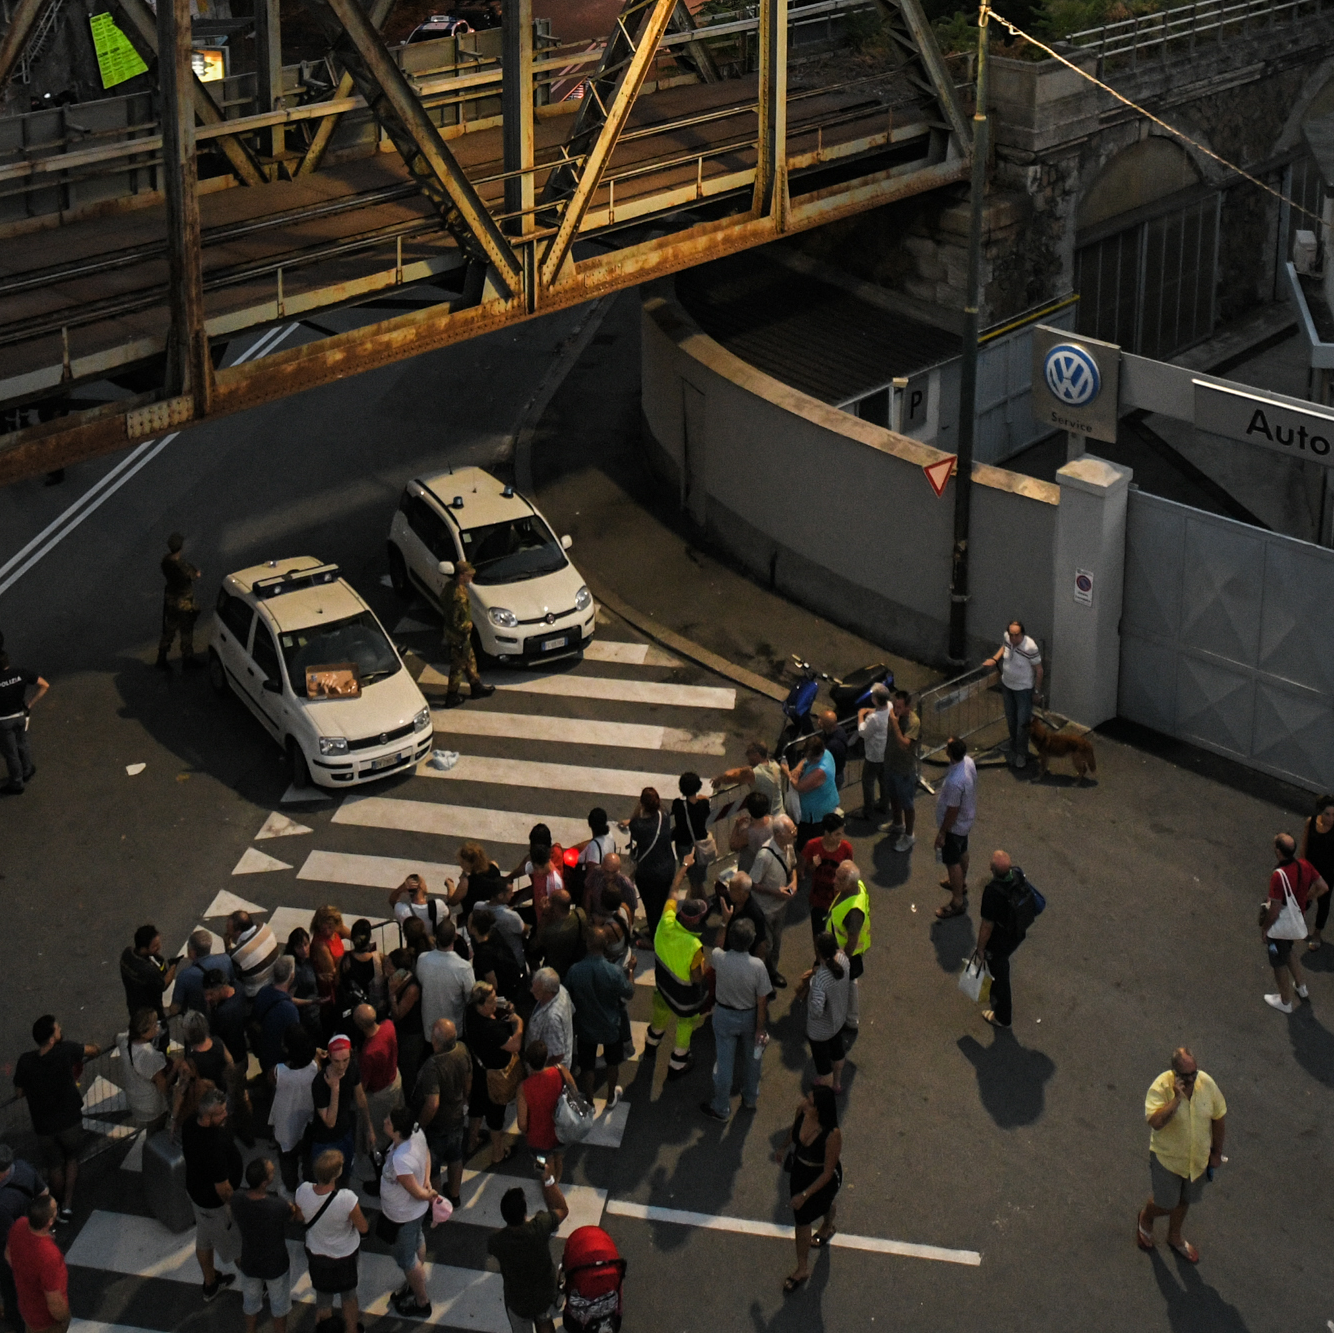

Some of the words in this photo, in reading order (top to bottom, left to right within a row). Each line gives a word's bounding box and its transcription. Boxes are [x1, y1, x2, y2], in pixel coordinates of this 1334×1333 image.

[910, 390, 922, 419] P
[1051, 411, 1093, 433] Service
[1246, 409, 1330, 457] Auto
